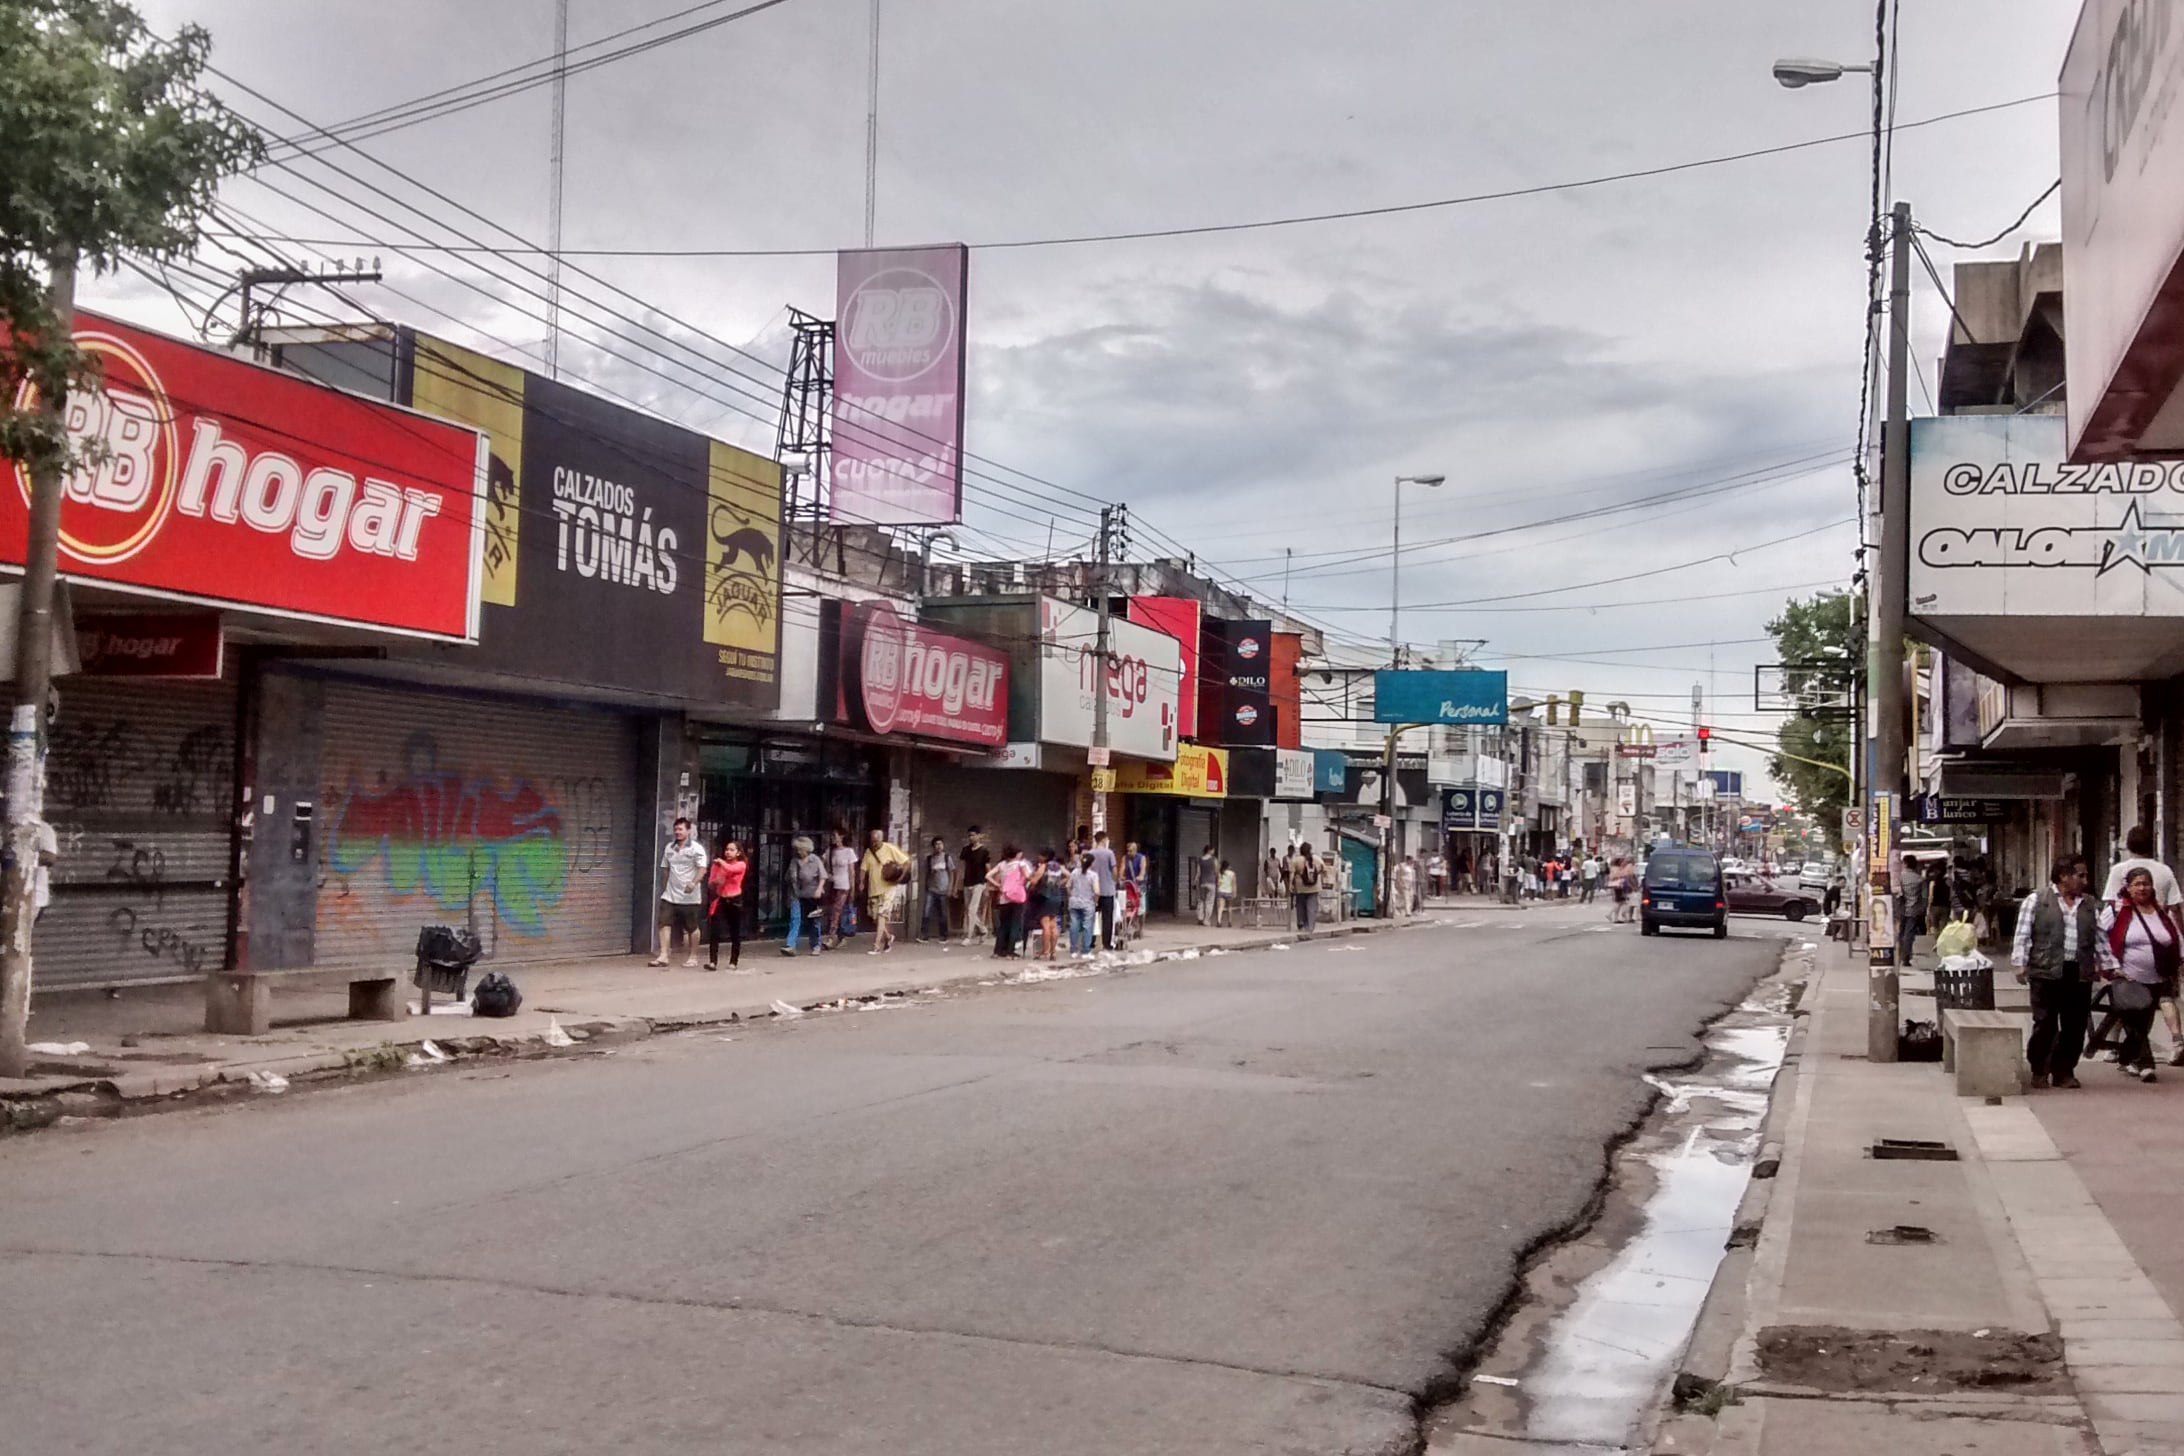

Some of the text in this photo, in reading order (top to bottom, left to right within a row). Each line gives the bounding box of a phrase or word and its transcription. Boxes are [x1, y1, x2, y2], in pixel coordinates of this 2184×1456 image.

[849, 287, 942, 349] RB
[837, 392, 956, 421] hogar
[177, 416, 443, 562] hogar
[553, 466, 635, 517] CALZADOS
[552, 497, 678, 595] TOMÁS
[716, 582, 767, 625] JAGUAR
[104, 635, 184, 659] hogar
[903, 626, 1004, 716] hogar
[1440, 700, 1500, 719] Personal
[1137, 780, 1174, 791] Digital
